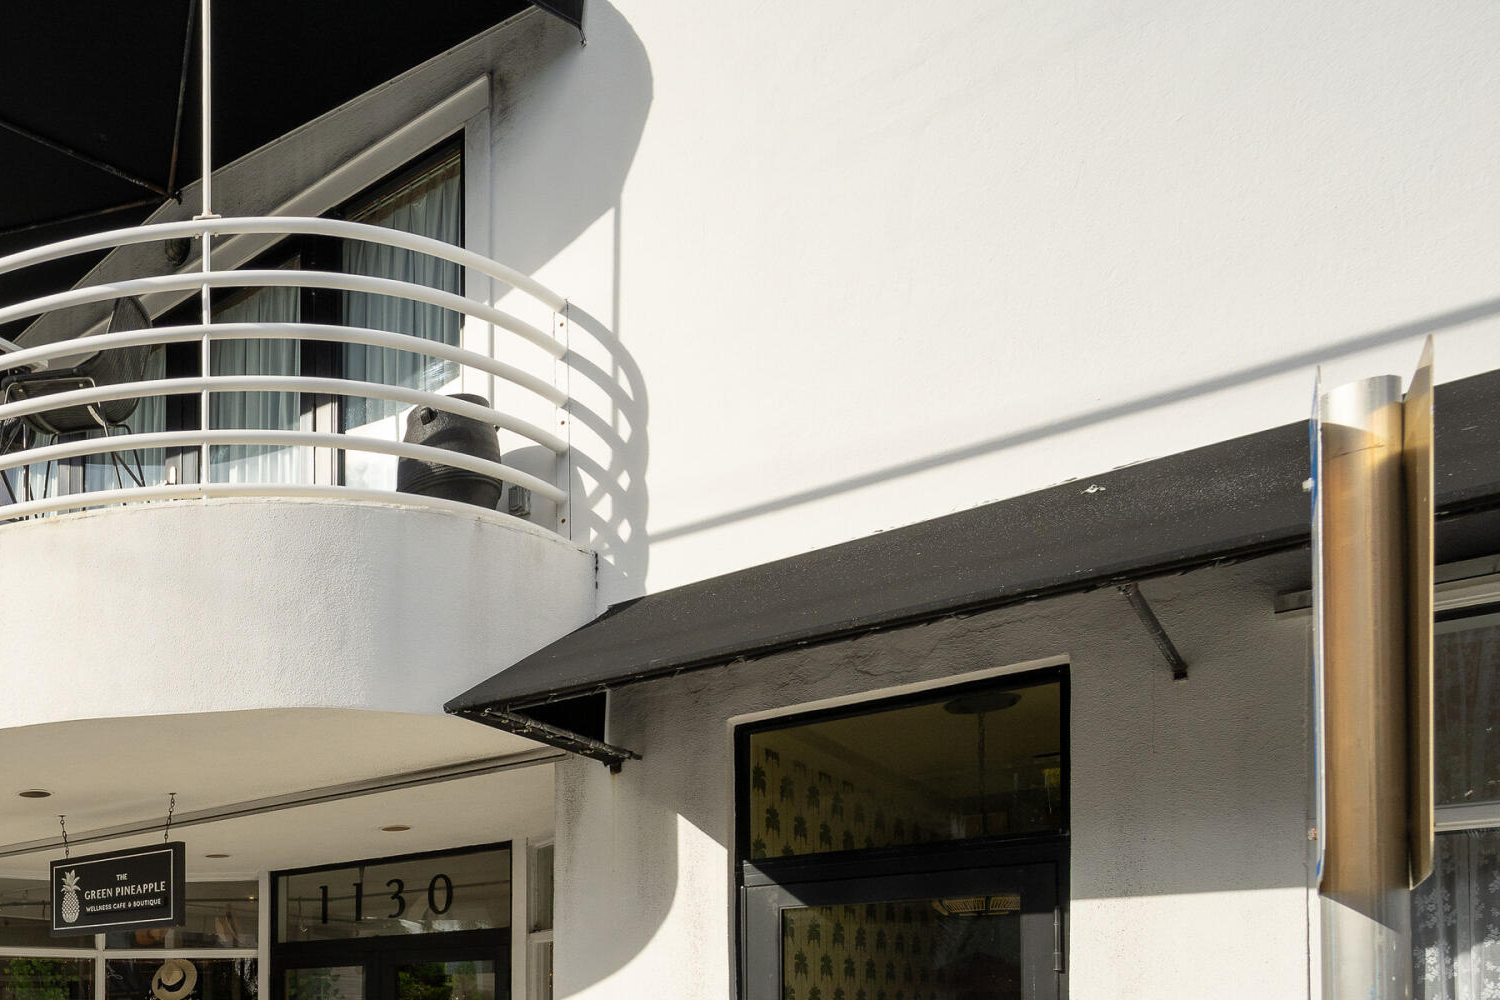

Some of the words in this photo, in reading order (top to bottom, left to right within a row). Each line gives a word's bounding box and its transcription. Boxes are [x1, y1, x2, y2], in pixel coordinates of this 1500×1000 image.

[116, 873, 128, 881] THE
[84, 887, 113, 900] GREEN
[115, 881, 166, 897] PINEAPPLE
[319, 873, 453, 924] 1130
[85, 904, 112, 912] WELLNESS
[133, 898, 161, 908] BOUTIQUE
